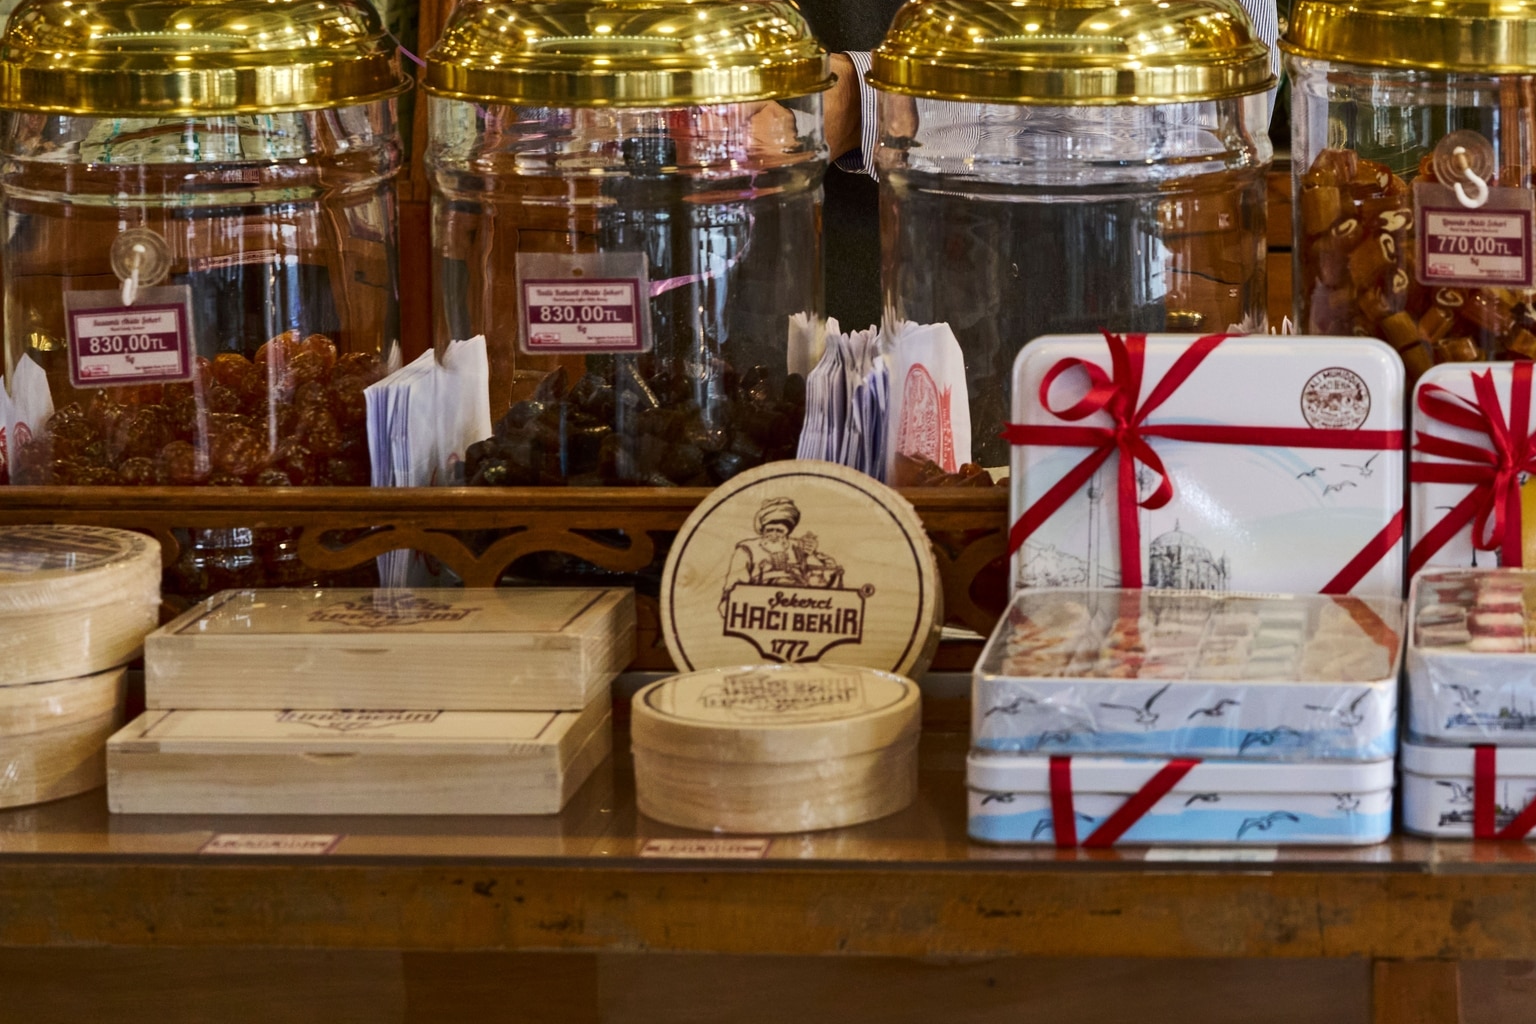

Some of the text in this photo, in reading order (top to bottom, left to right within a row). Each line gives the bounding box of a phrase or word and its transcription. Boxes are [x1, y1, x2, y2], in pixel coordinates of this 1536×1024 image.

[1437, 236, 1512, 255] 770,00TL
[540, 305, 622, 323] 830,00TL
[89, 334, 168, 353] 830,00TL
[768, 591, 833, 610] Şekerci
[792, 608, 858, 635] BEKİR
[770, 639, 810, 662] 1777
